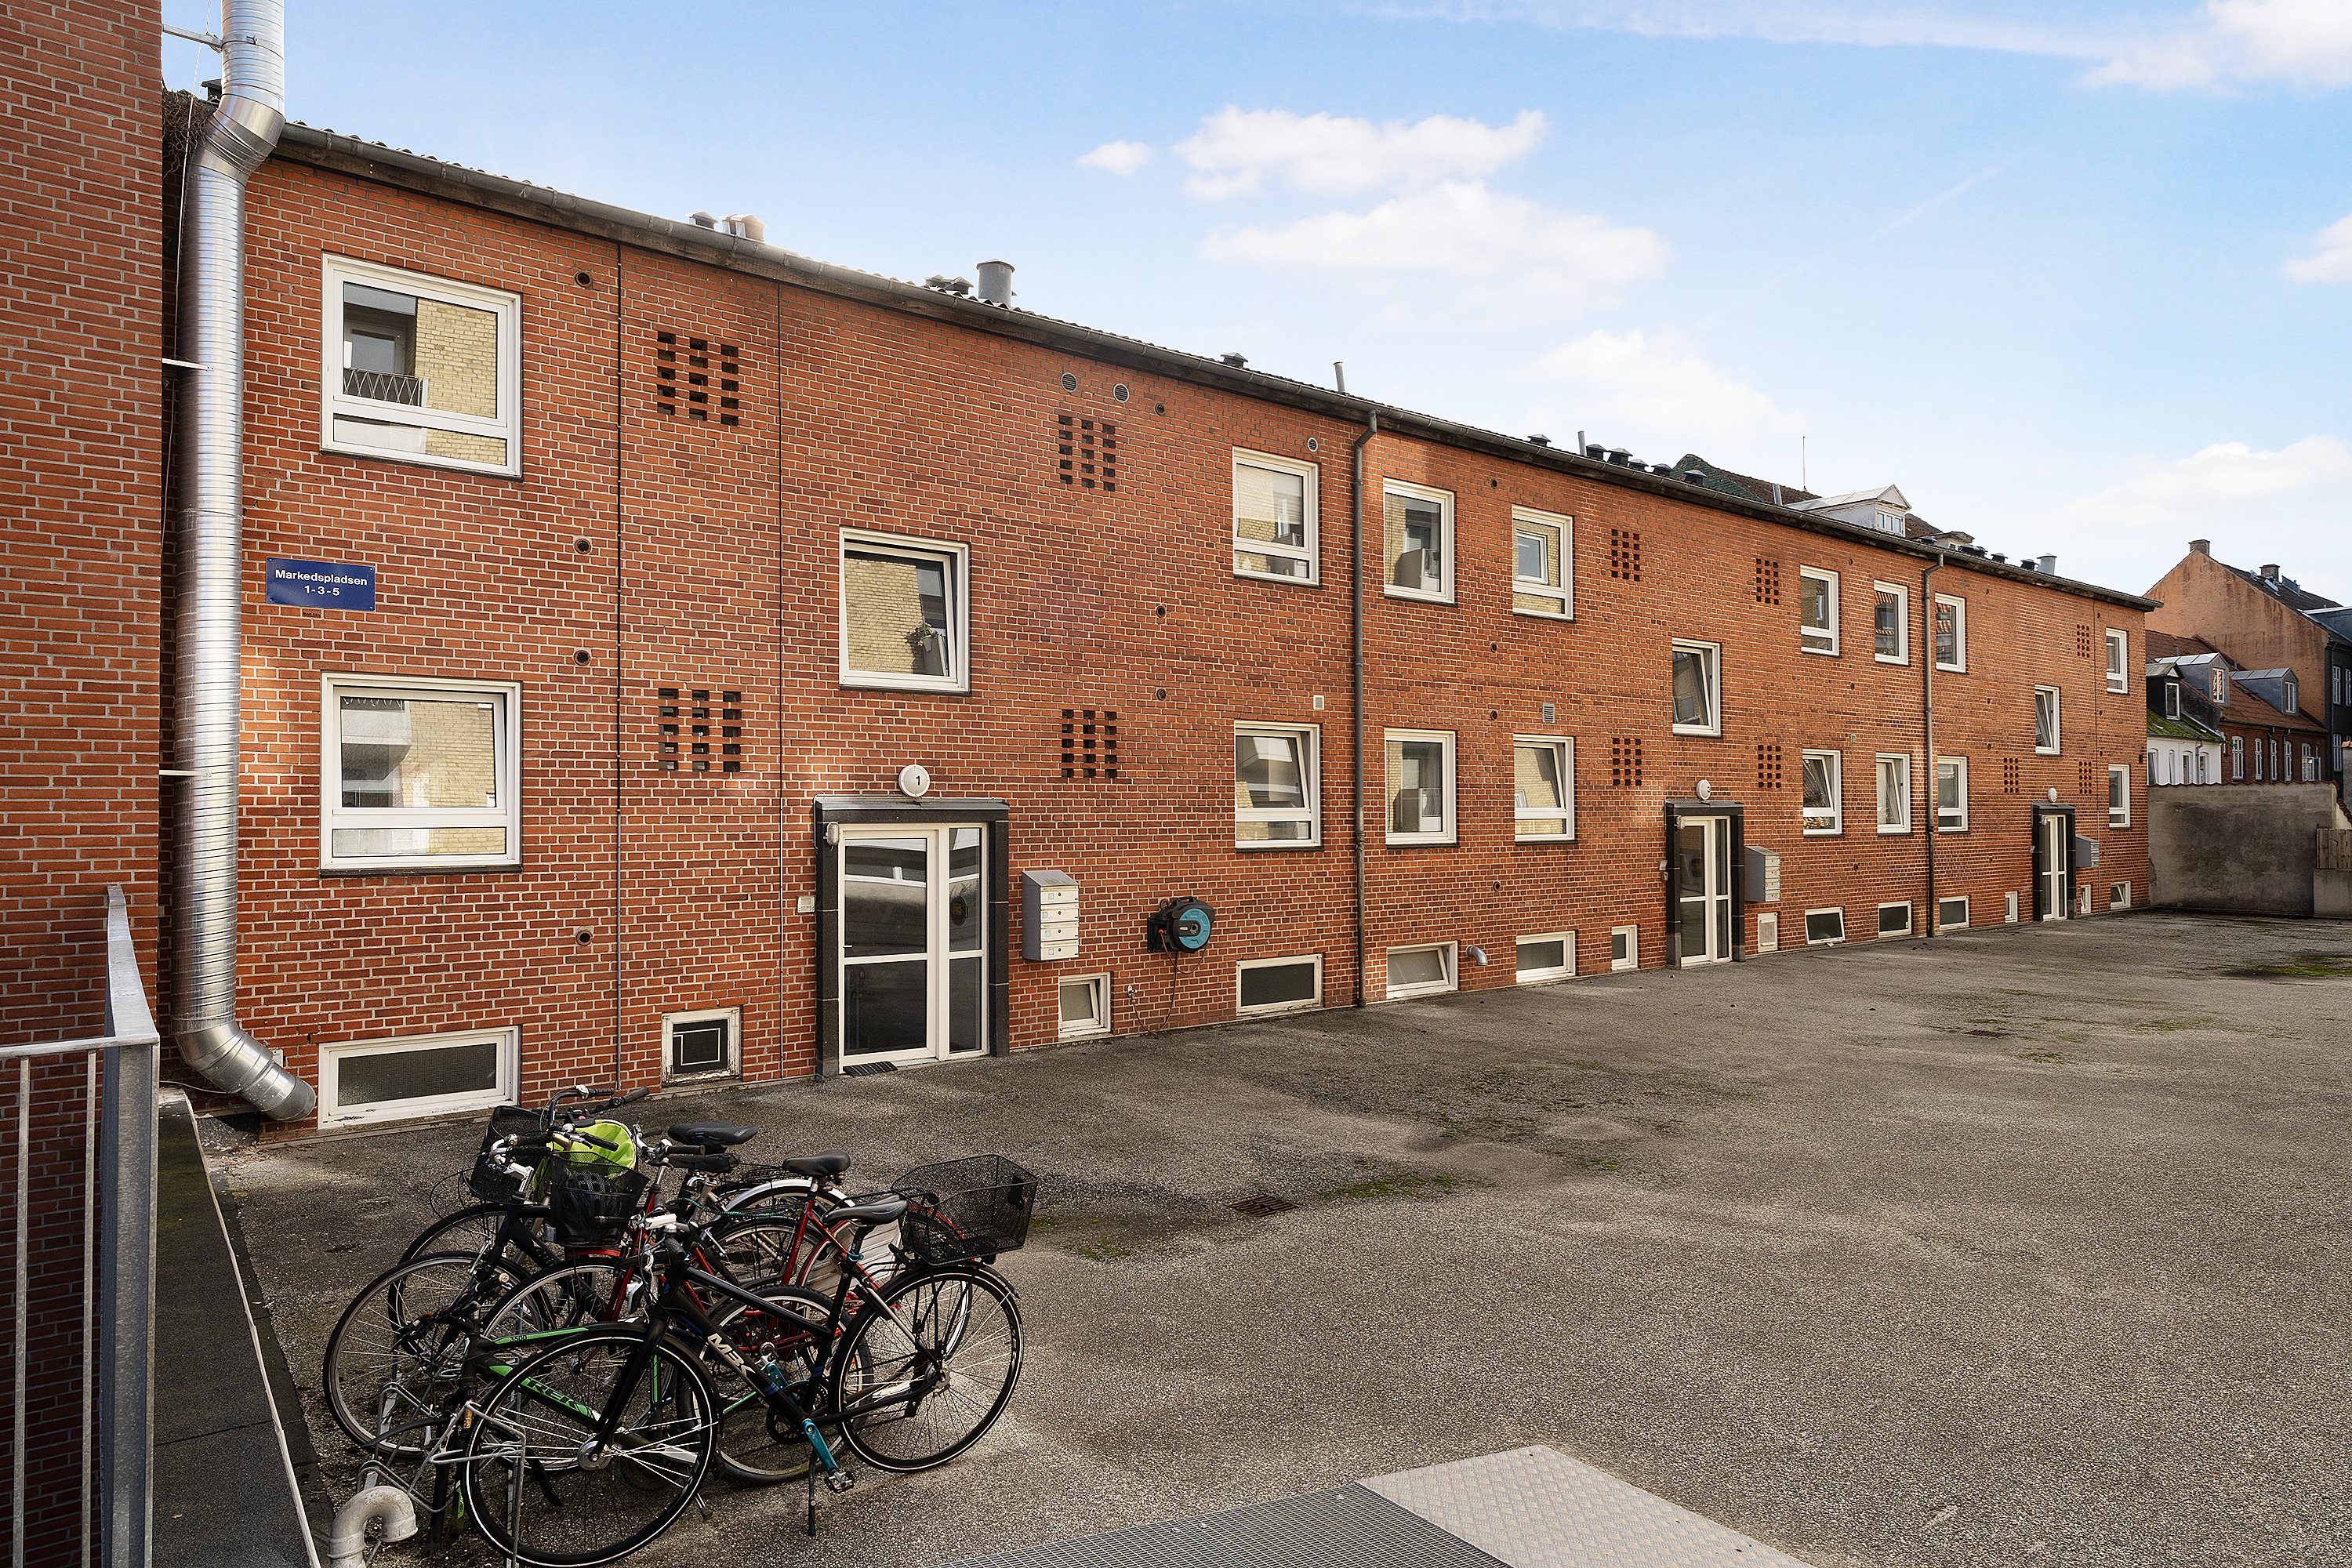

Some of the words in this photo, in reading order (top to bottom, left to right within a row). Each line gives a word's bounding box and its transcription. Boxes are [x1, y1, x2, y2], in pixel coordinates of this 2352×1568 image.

[275, 569, 368, 586] Markedspladsen
[915, 775, 920, 786] 1
[525, 1377, 582, 1412] TREK
